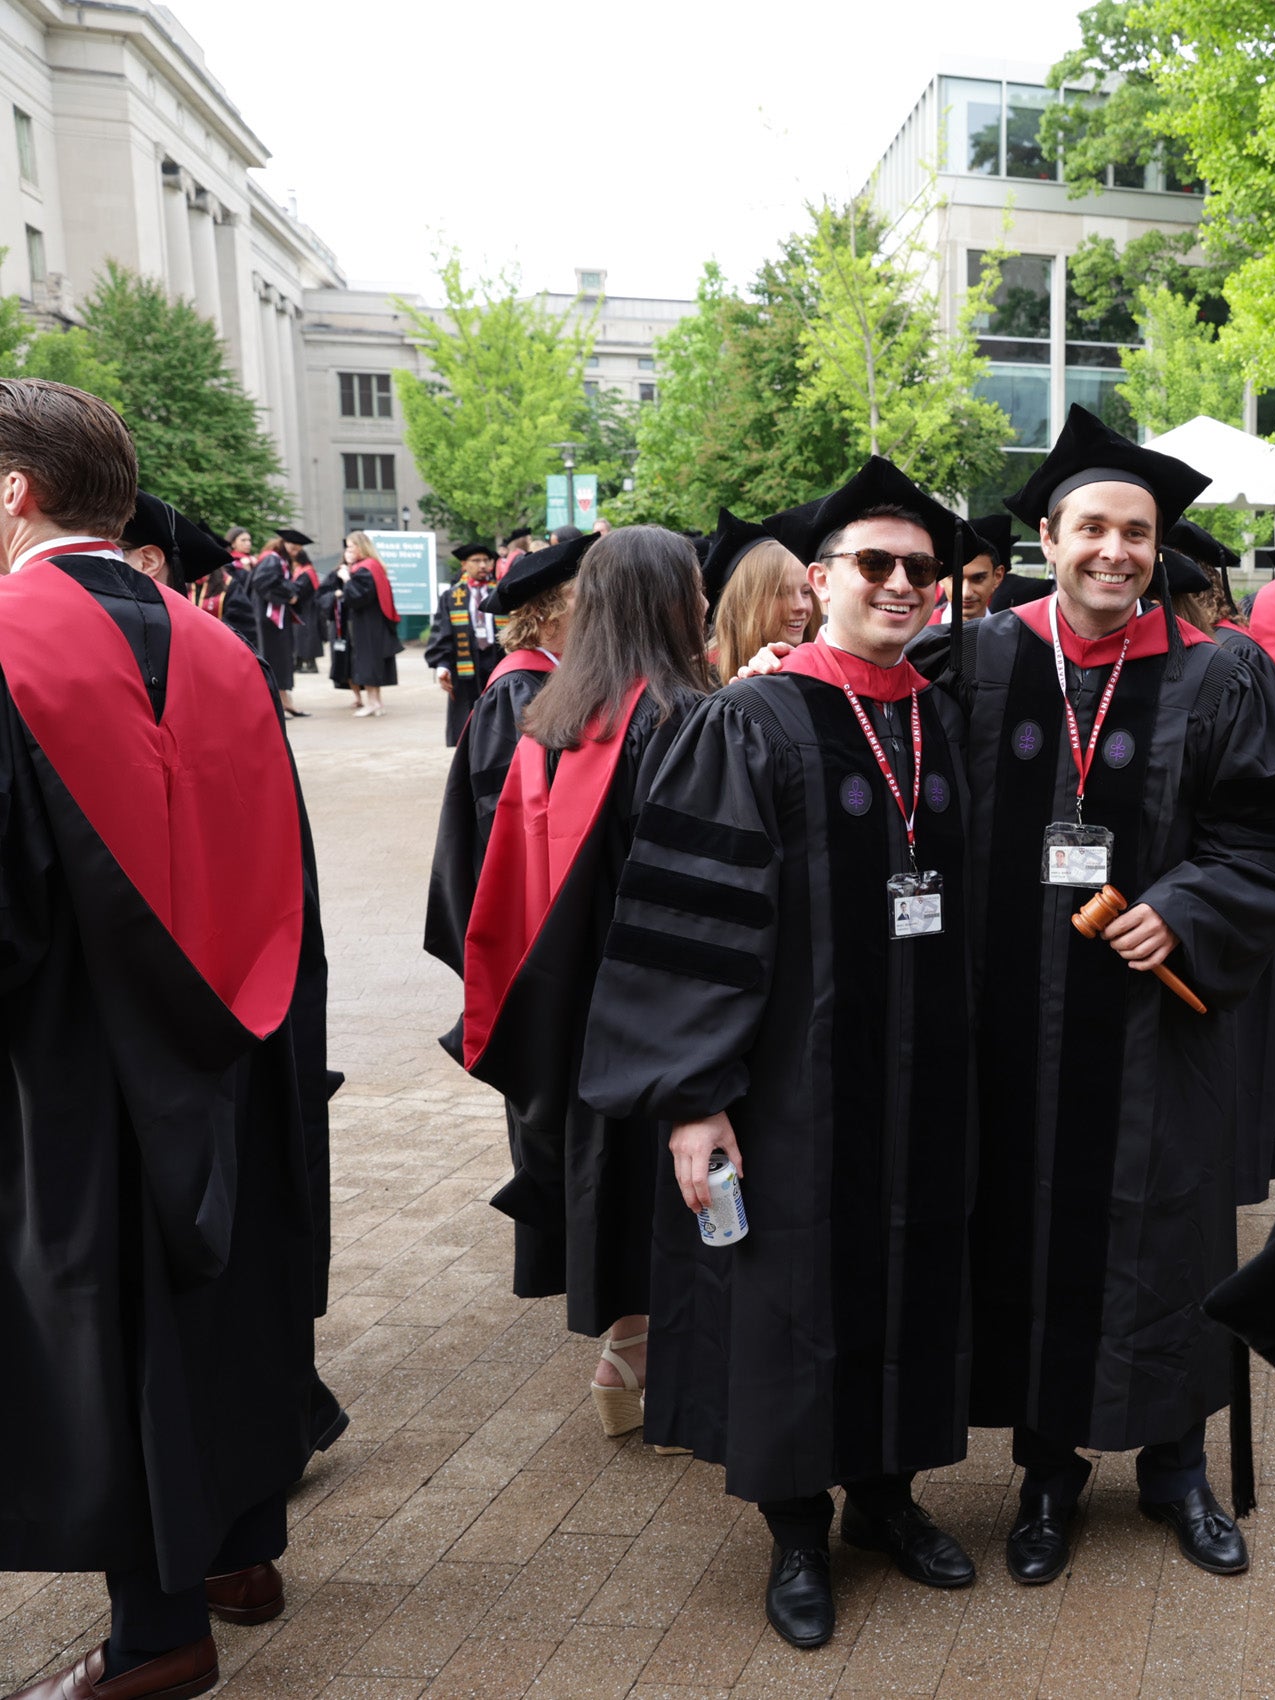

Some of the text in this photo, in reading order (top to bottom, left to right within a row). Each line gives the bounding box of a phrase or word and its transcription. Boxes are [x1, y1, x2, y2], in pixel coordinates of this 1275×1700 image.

[911, 687, 921, 742] UNIVERSITY
[1099, 638, 1130, 715] COMMENCEMENT
[843, 683, 886, 763] COMMENCEMENT
